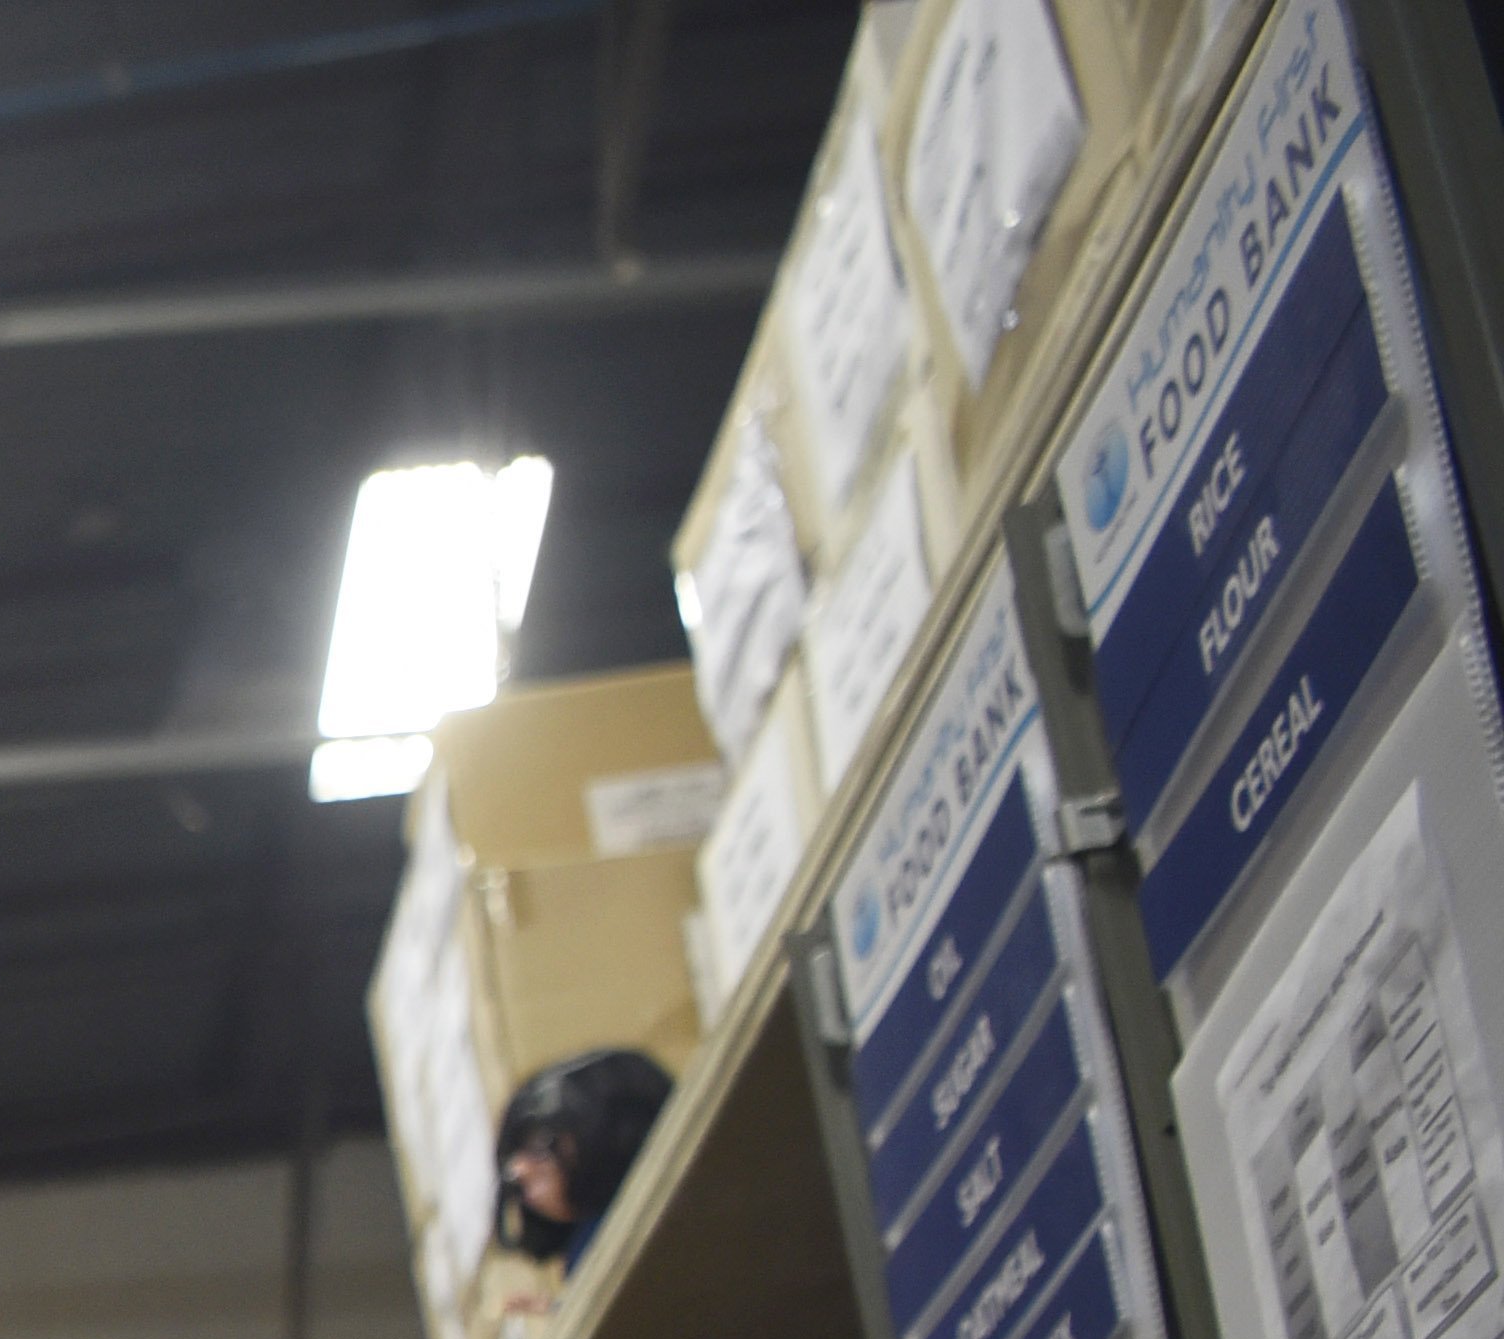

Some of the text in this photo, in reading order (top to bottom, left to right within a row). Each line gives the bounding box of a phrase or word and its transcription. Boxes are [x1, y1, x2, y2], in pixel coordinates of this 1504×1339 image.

[1140, 61, 1343, 482] FOOD BANK
[1188, 431, 1245, 558] RICE
[1199, 514, 1280, 676] FLOUR
[1230, 674, 1324, 834] CEREAL
